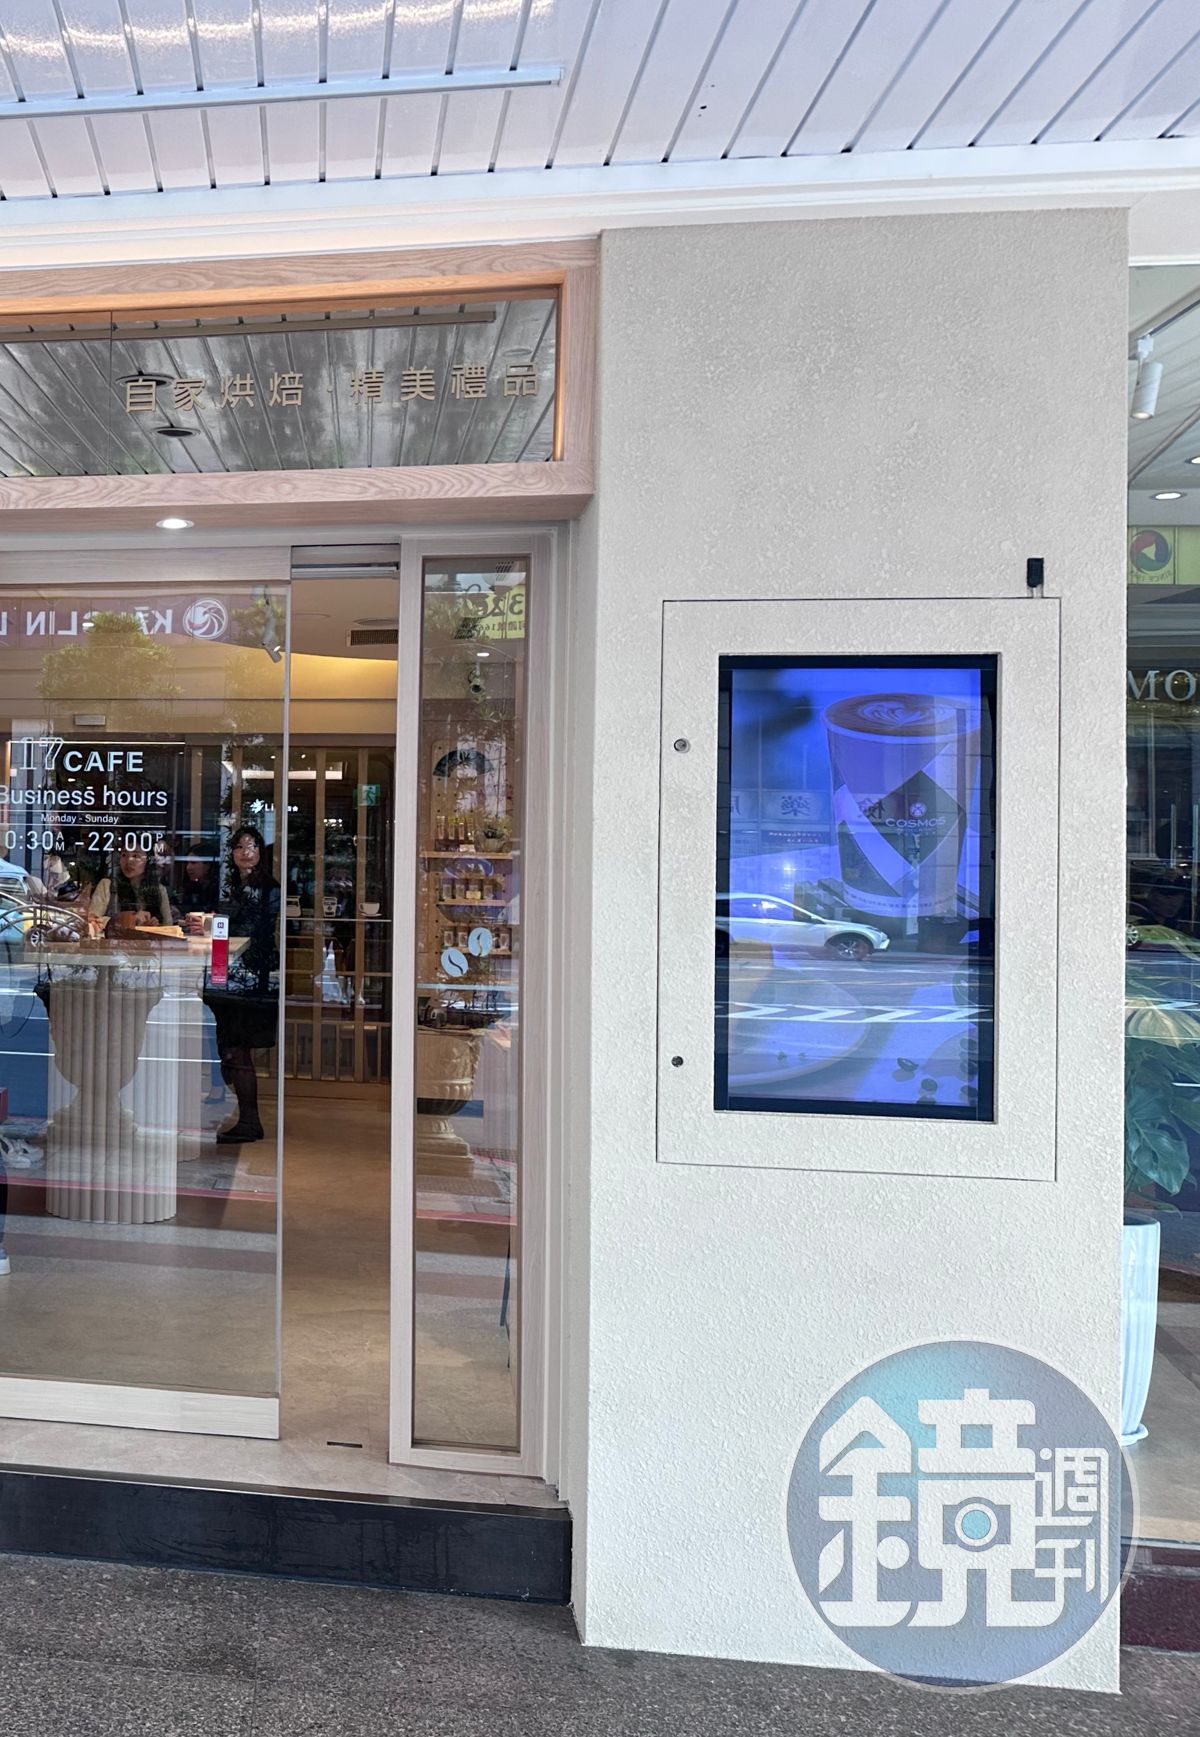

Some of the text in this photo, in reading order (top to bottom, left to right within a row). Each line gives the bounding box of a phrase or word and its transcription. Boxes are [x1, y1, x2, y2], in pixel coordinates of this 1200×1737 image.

[103, 785, 168, 807] hours
[41, 813, 77, 824] Monday
[85, 813, 119, 825] Sunday
[885, 815, 946, 828] COSMOS
